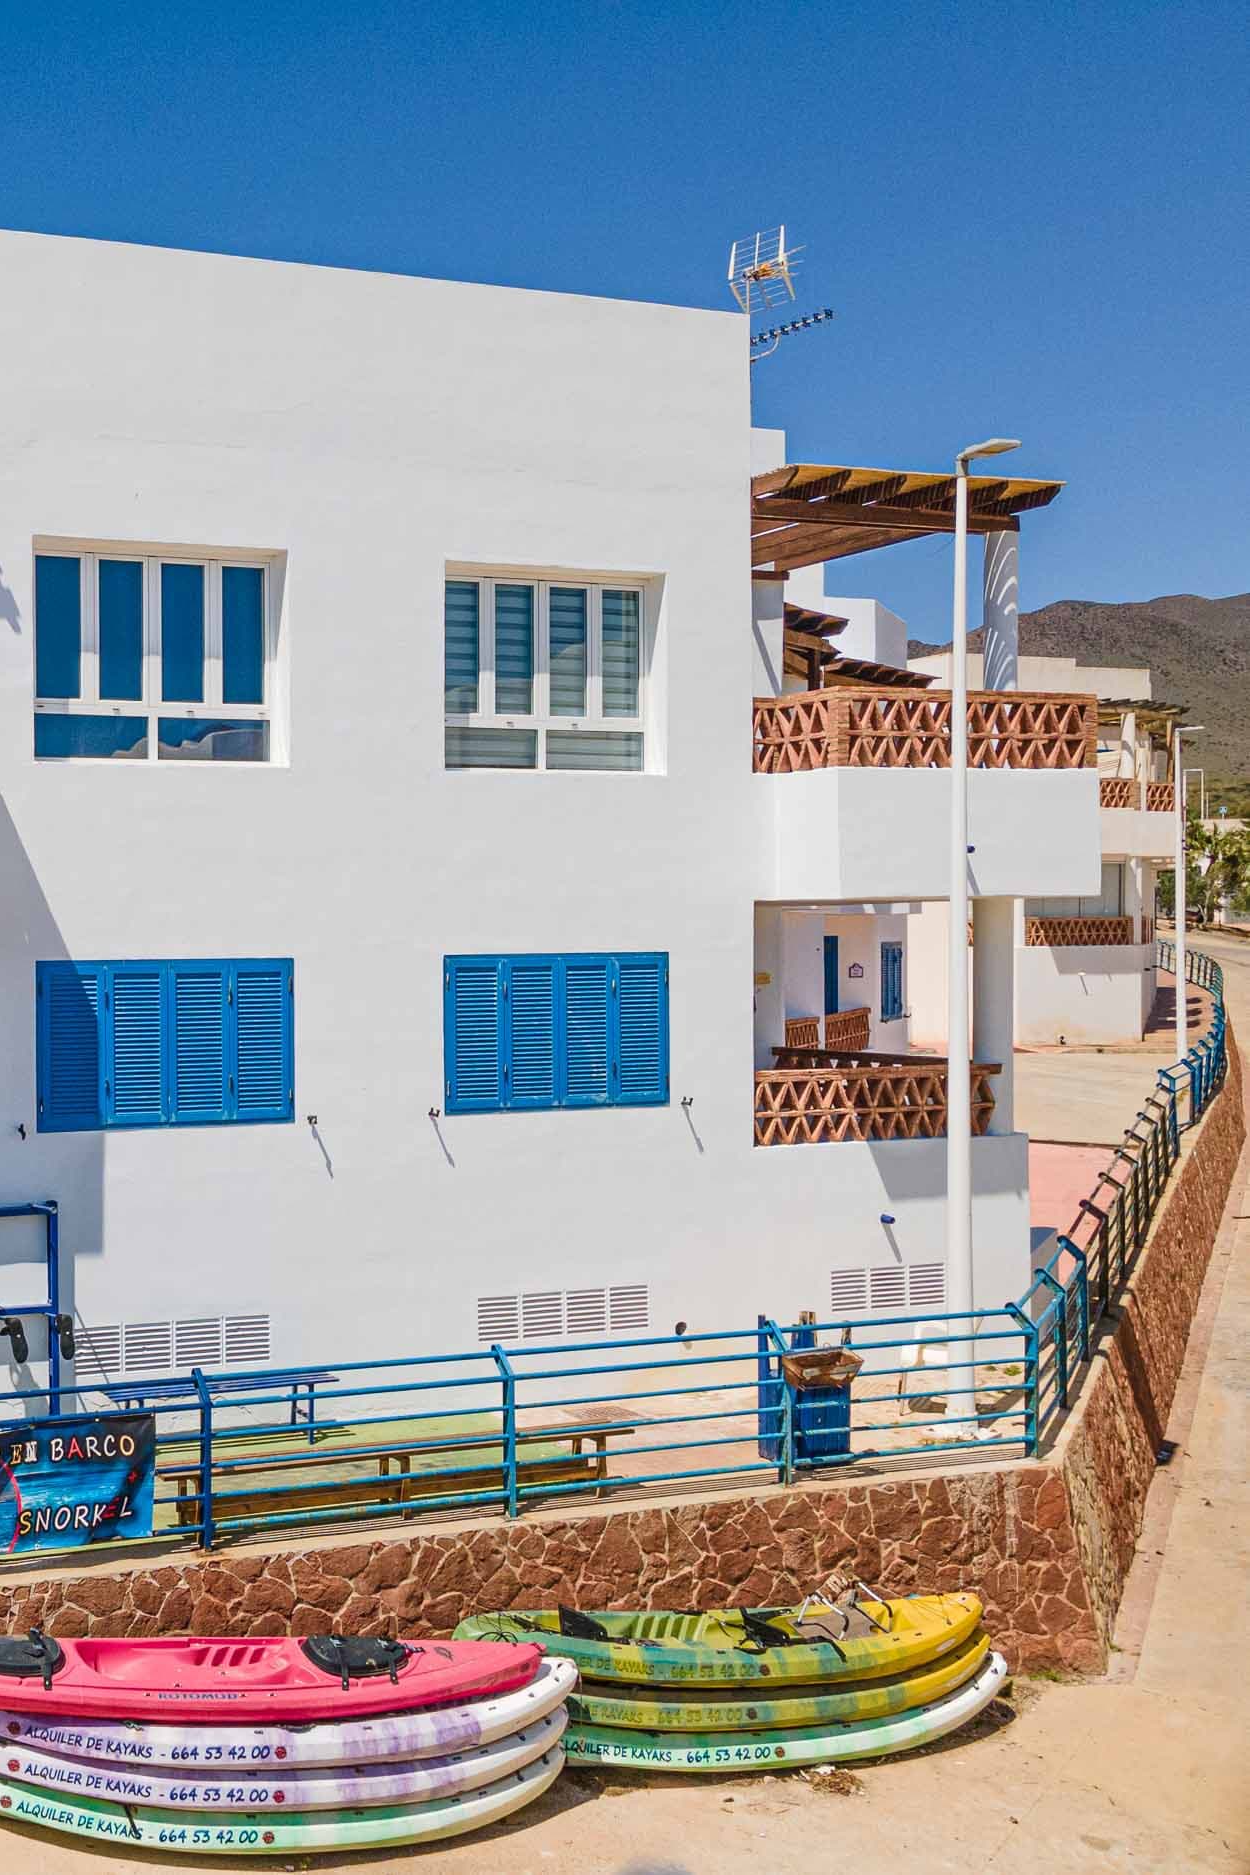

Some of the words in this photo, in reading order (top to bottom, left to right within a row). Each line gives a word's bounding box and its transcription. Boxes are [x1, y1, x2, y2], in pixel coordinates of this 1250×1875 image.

[9, 1440, 38, 1465] EN
[50, 1434, 136, 1462] BARCO
[19, 1495, 134, 1535] SNORKEL
[24, 1726, 83, 1747] ALQUILER
[86, 1737, 104, 1750] DE
[106, 1740, 153, 1758] KAYAKS
[171, 1746, 199, 1760] 664
[204, 1746, 223, 1759] 53
[228, 1746, 247, 1759] 42
[251, 1746, 270, 1759] 00
[613, 1745, 628, 1757] DE
[631, 1744, 672, 1763] KAYAKS
[686, 1750, 710, 1762] 664
[715, 1749, 730, 1761] 53
[735, 1748, 751, 1760] 42
[755, 1746, 771, 1759] 00
[24, 1763, 83, 1785] ALQUILER
[85, 1775, 104, 1789] DE
[105, 1779, 152, 1798] KAYAKS
[169, 1788, 197, 1801] 664
[202, 1788, 222, 1801] 53
[226, 1788, 245, 1801] 42
[249, 1788, 269, 1801] 00
[16, 1801, 74, 1824] ALQUILER
[77, 1815, 95, 1829] DE
[96, 1819, 143, 1840] KAYAKS
[158, 1830, 188, 1844] 664
[192, 1829, 211, 1843] 53
[215, 1829, 235, 1843] 42
[238, 1829, 258, 1843] 00
